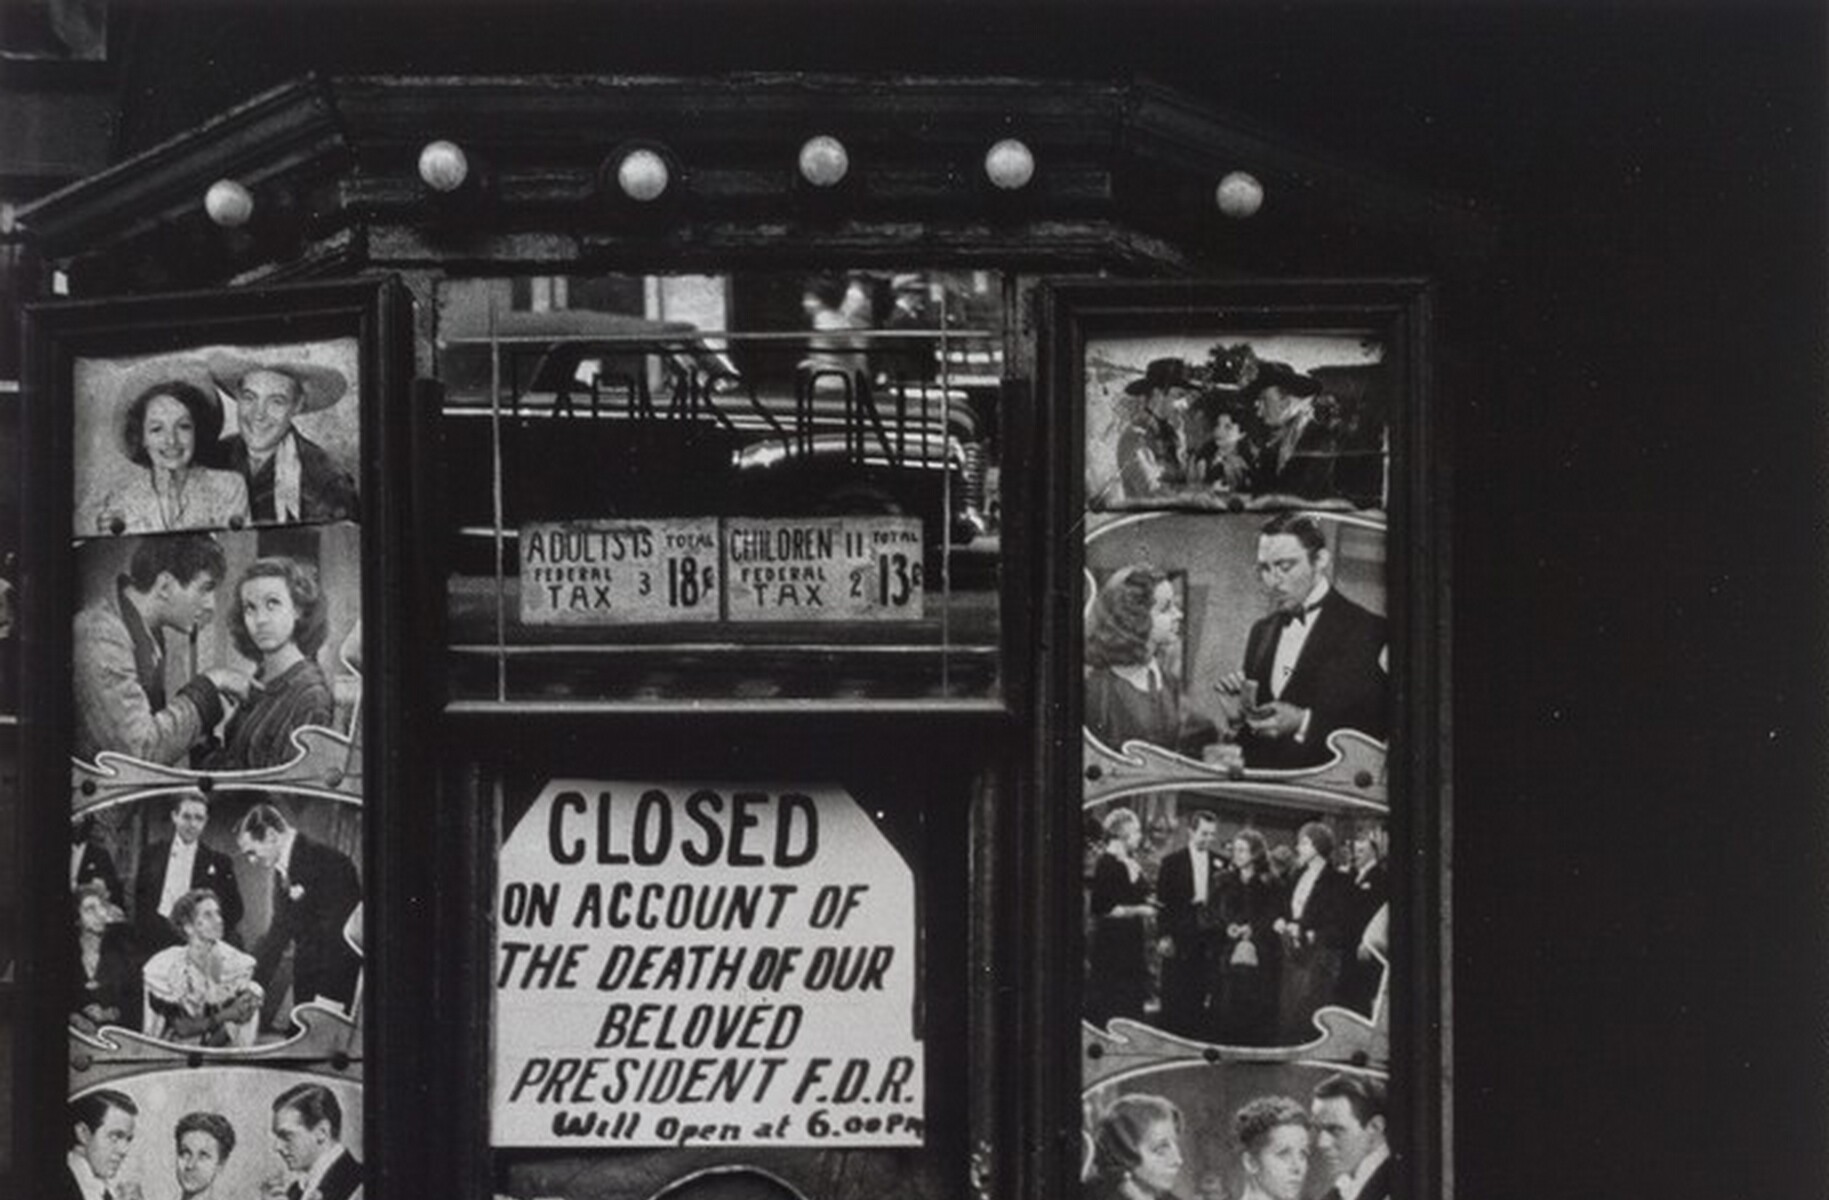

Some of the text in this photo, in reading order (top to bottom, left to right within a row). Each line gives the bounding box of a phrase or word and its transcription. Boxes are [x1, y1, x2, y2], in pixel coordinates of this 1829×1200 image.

[527, 527, 653, 564] ADULTS 15
[666, 533, 715, 549] TOTAL
[730, 528, 864, 562] CHILDREN 11
[872, 530, 919, 545] TOTAL
[535, 567, 613, 583] FEDERAL
[548, 571, 652, 610] TAX 3
[741, 566, 827, 583] FEDERAL
[753, 571, 862, 607] TAX 2
[549, 788, 819, 868] CLOSED
[502, 882, 870, 930] ON ACCOUNT OF
[497, 942, 895, 992] THE DEATH OF OUR
[594, 1003, 804, 1050] BELOVED
[508, 1055, 915, 1105] PRESIDENT F.D.R.
[551, 1111, 641, 1140] Will
[655, 1117, 742, 1147] Open
[752, 1115, 791, 1139] at
